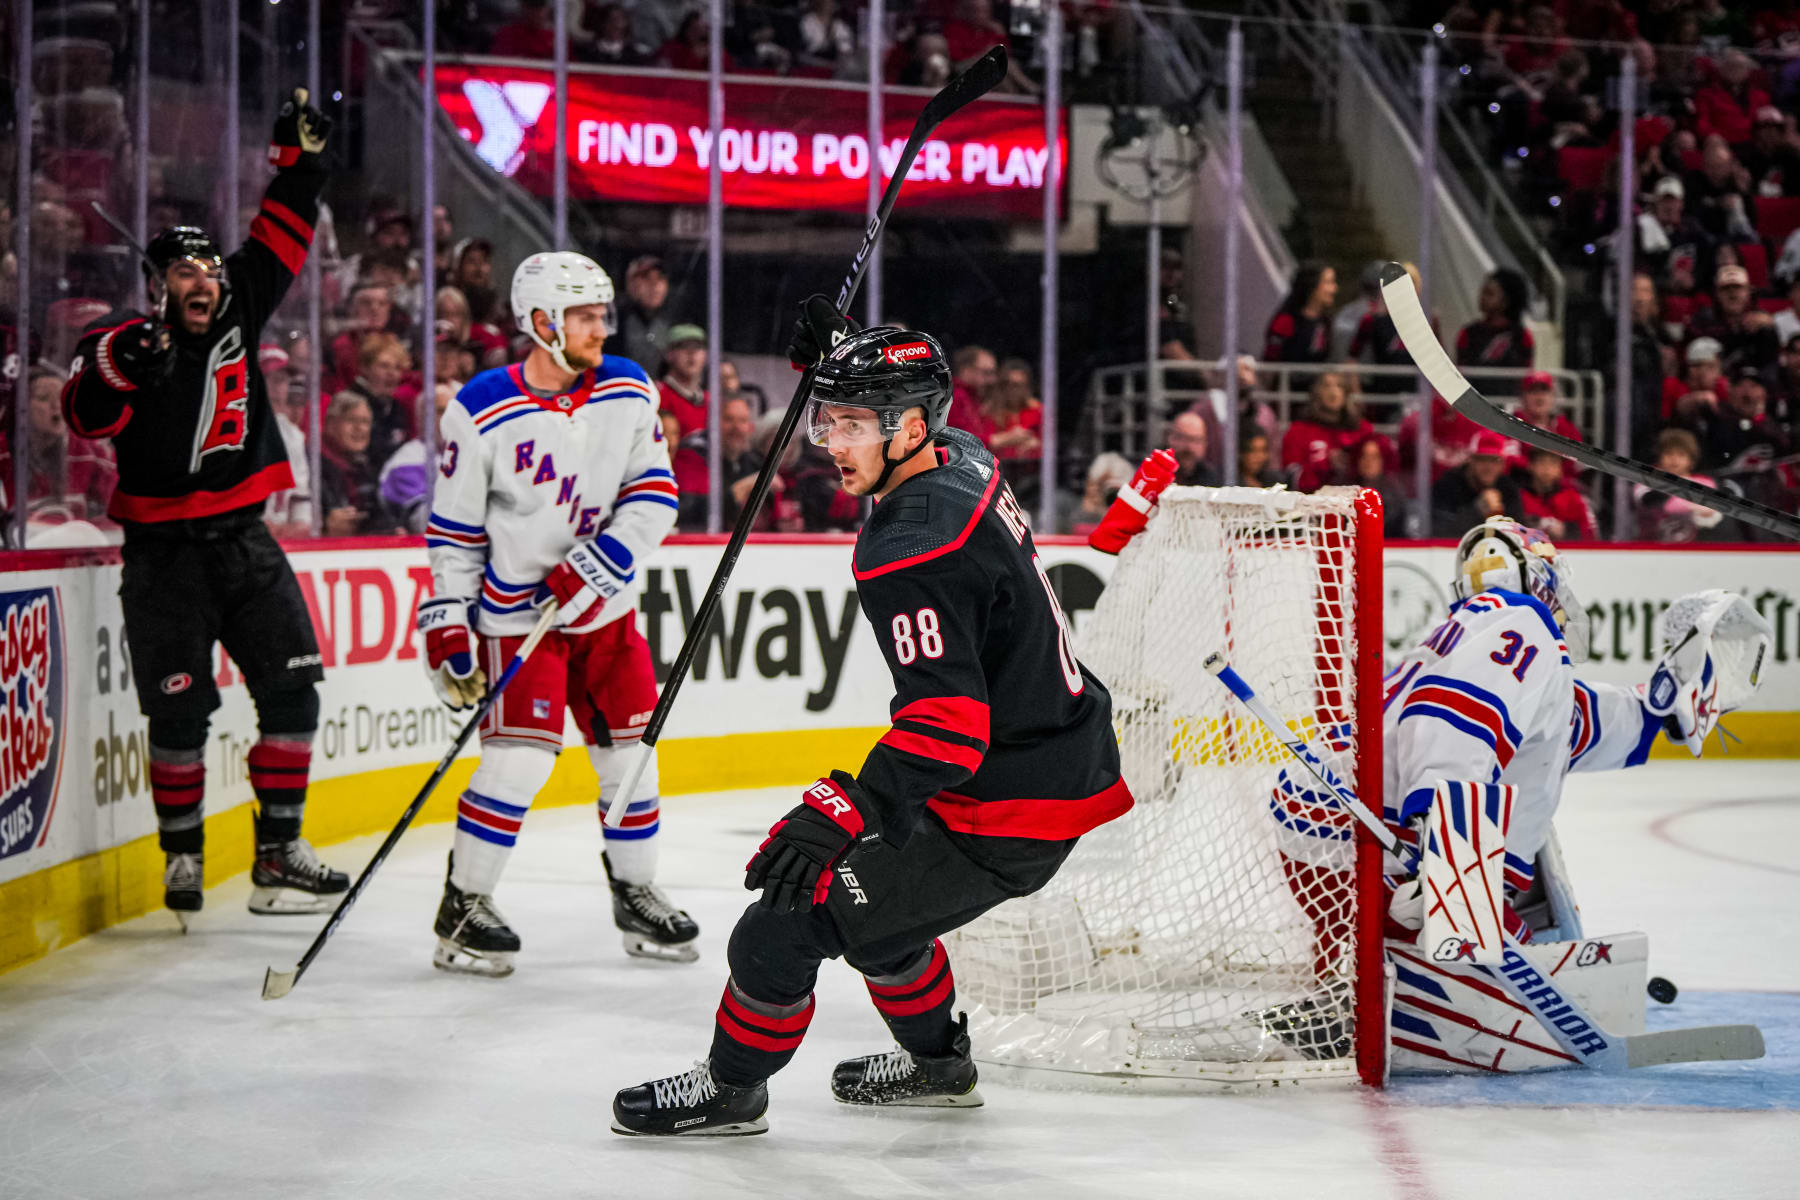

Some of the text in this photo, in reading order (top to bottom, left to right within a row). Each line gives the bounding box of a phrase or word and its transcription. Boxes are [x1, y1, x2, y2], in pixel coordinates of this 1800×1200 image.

[578, 120, 678, 167] FIND
[688, 125, 798, 175] YOUR
[961, 142, 1049, 189] PLAY
[887, 345, 927, 363] Lenovo
[891, 607, 945, 667] 88
[1489, 629, 1540, 684] 31
[323, 707, 347, 760] of
[355, 704, 464, 754] Dreams
[1, 797, 34, 853] SUBS
